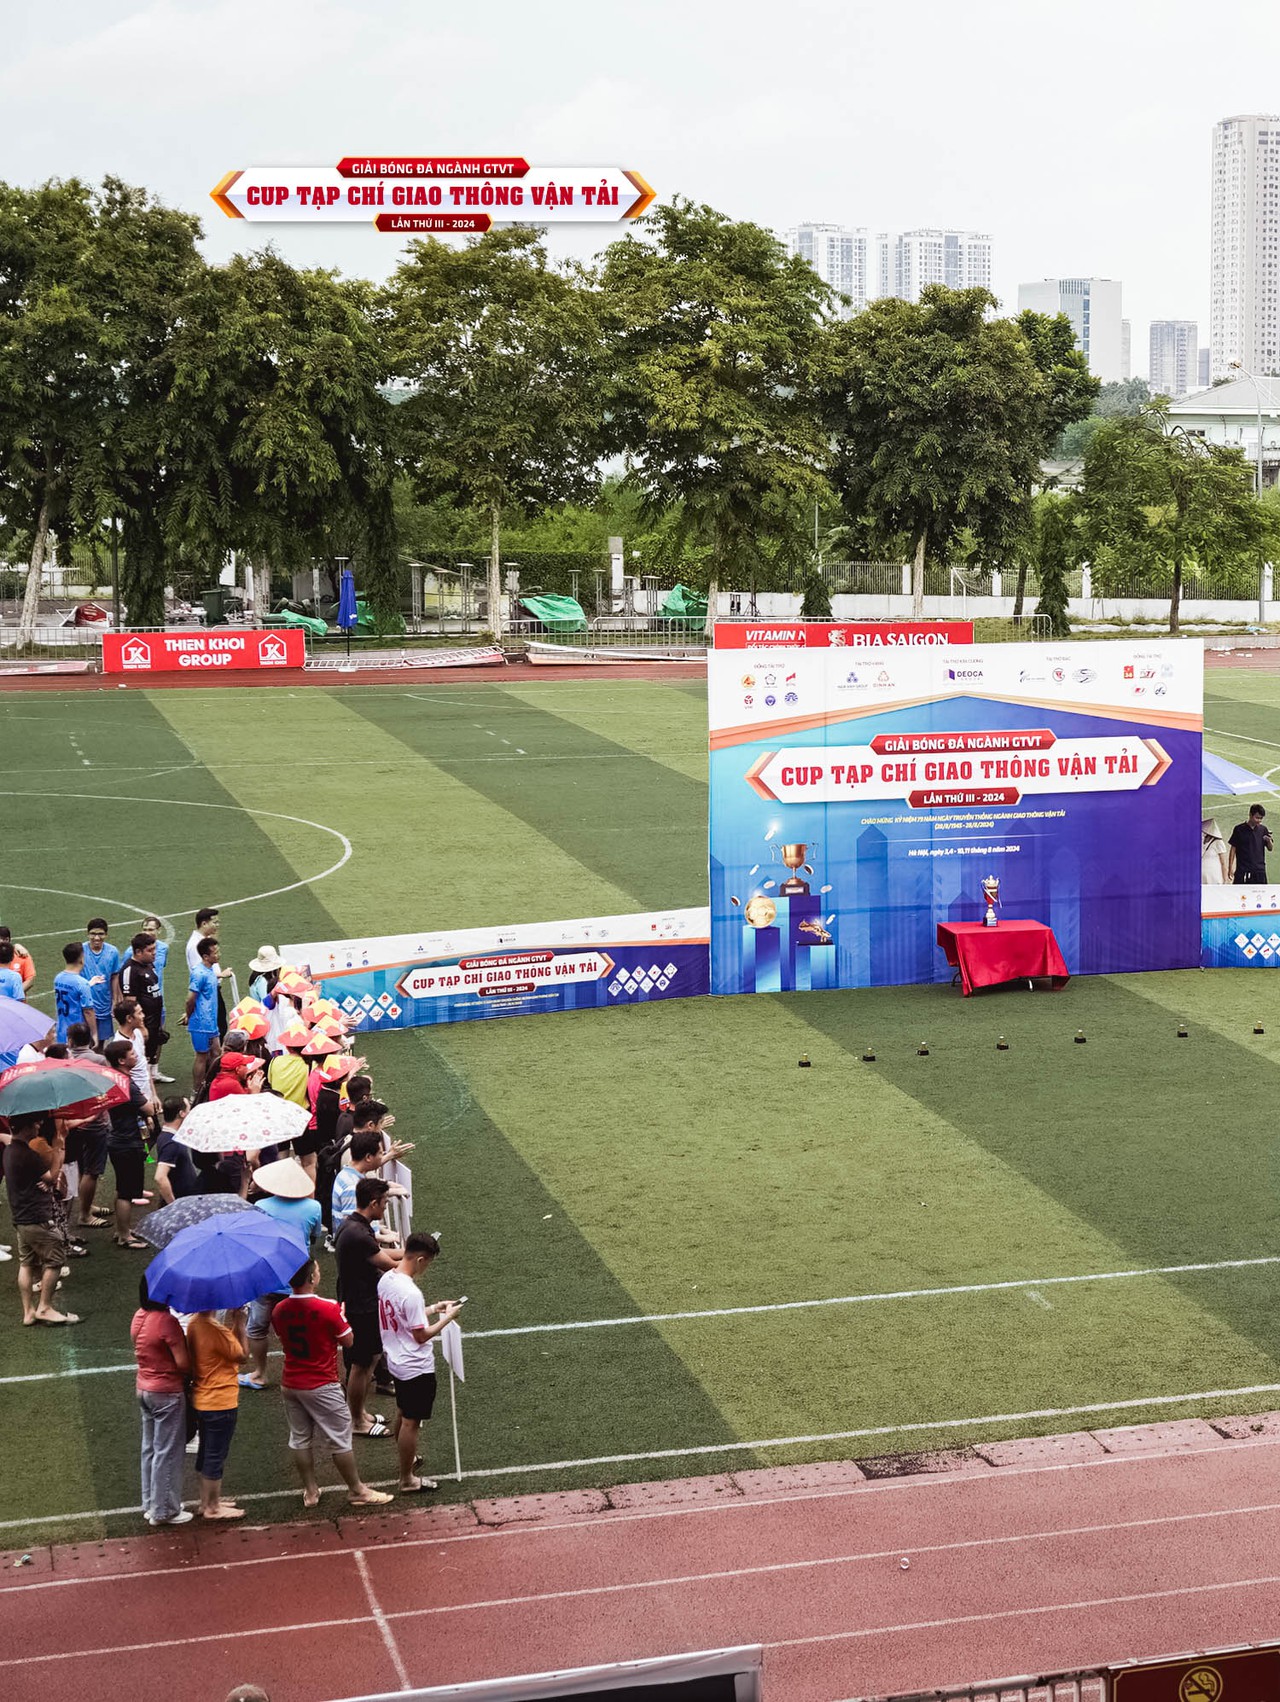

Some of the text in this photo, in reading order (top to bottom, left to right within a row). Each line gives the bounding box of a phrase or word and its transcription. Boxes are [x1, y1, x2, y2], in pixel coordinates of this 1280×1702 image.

[745, 630, 796, 641] VITAMIN
[852, 632, 949, 647] BIA SAIGON
[164, 637, 245, 652] THIEN KHOI
[178, 653, 233, 667] GROUP
[884, 735, 1042, 752] GIẢI BÓNG ĐÁ NGÀNH GTVT
[781, 748, 1138, 789] CUP TẠP CHÍ GIAO THÔNG VẬN TẢI
[923, 791, 943, 804] LẦN
[944, 791, 964, 804] THỨ
[965, 793, 975, 803] III
[982, 792, 1005, 803] 2024
[465, 960, 479, 969] GIẢI
[480, 958, 497, 967] BÓNG
[508, 956, 530, 965] NGÀNH
[531, 954, 547, 962] GTVT
[413, 958, 598, 990] CUP TẠP CHÍ GIAO THÔNG VẬN TẢI
[288, 1325, 311, 1360] 5
